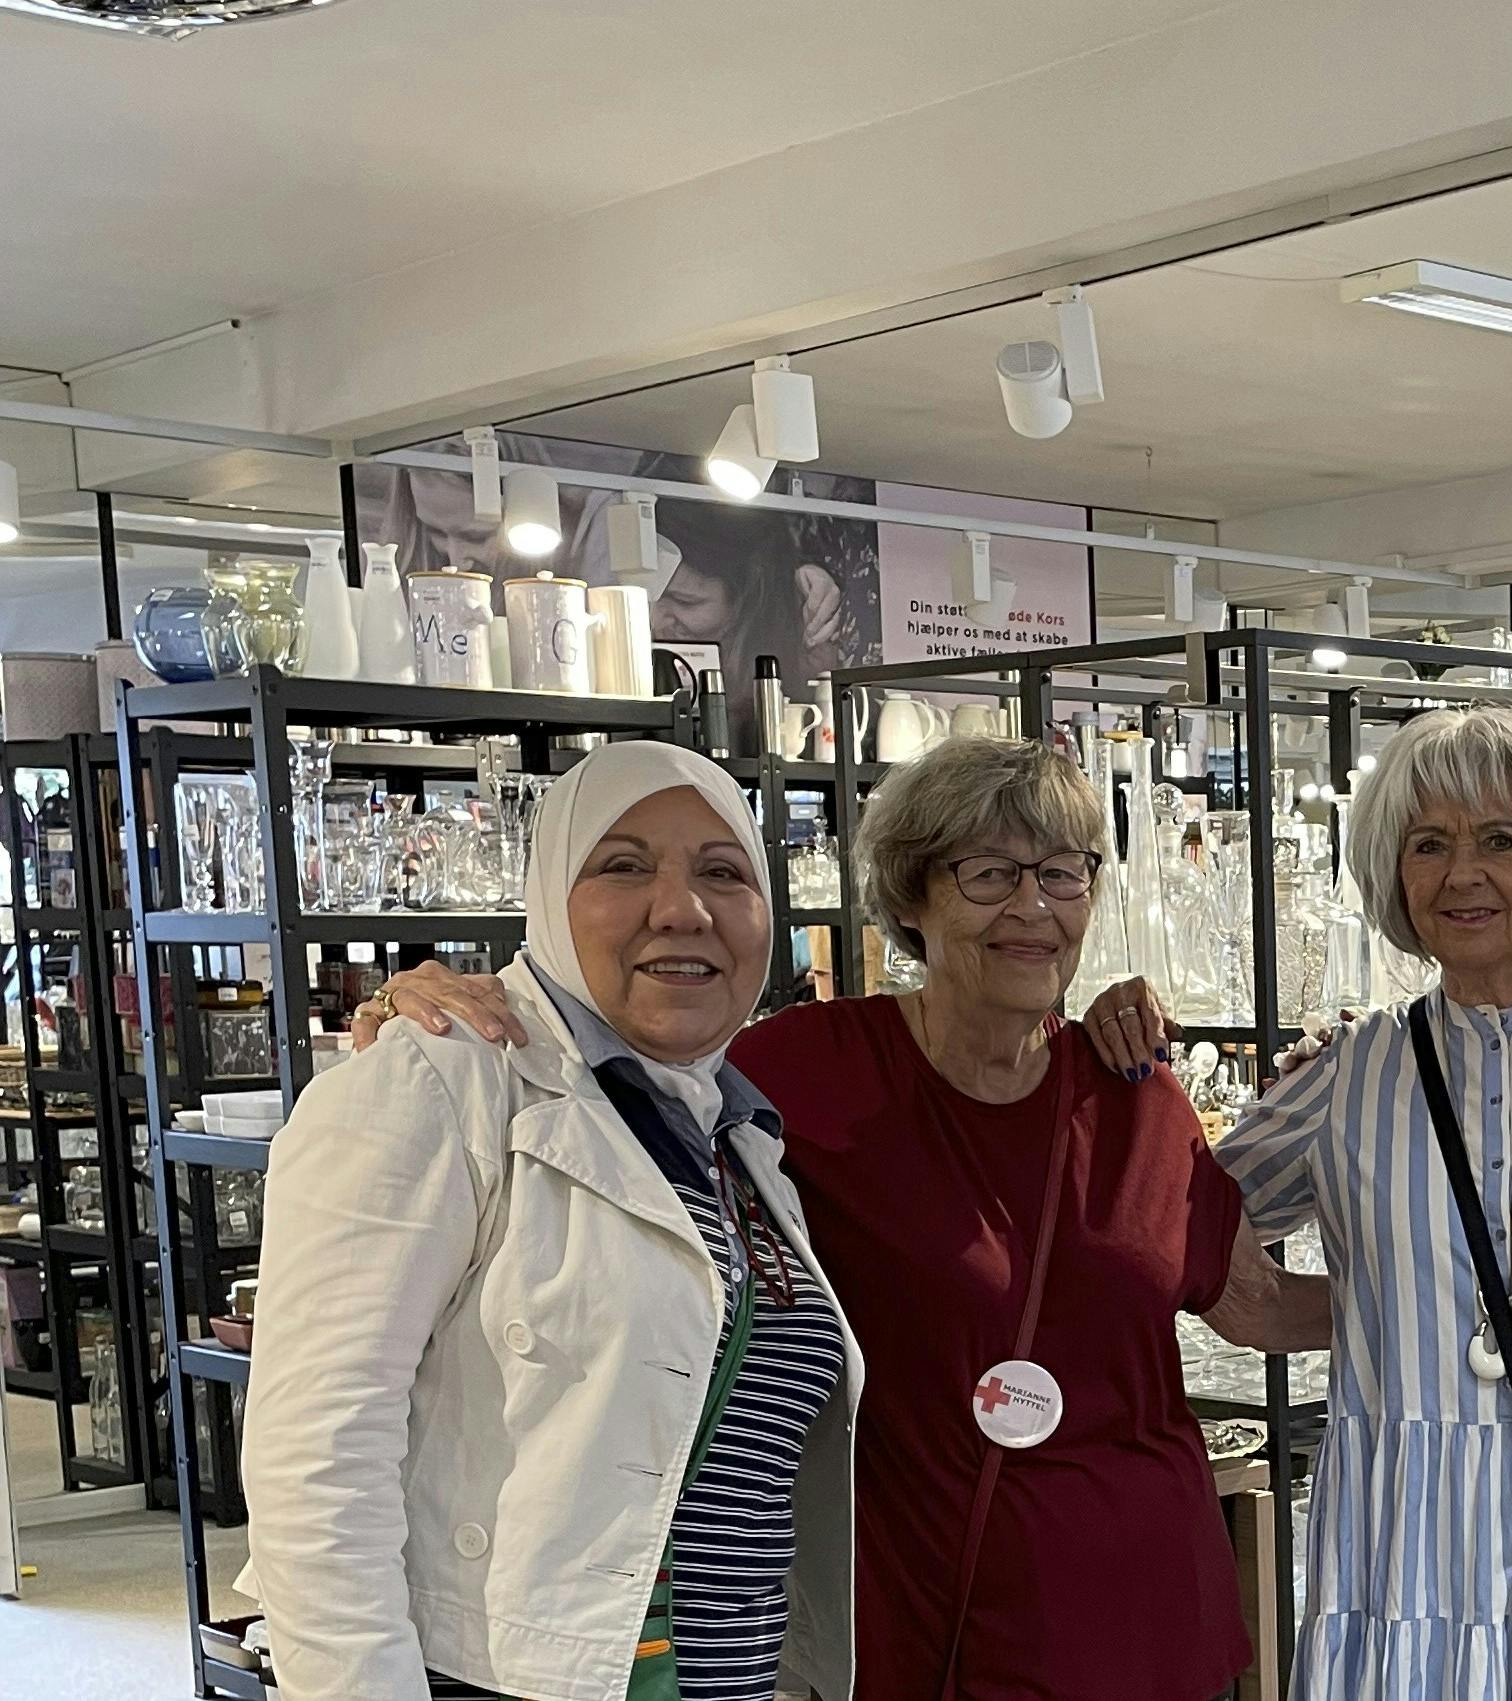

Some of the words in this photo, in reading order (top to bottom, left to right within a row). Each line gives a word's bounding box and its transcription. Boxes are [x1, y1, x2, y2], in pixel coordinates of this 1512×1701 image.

[911, 600, 933, 614] Din
[937, 603, 968, 617] støt
[1008, 609, 1032, 623] øde
[1036, 612, 1065, 626] Kors
[907, 620, 958, 638] hjælper
[963, 628, 979, 639] os
[983, 628, 1011, 641] med
[1015, 631, 1028, 643] at
[1032, 632, 1068, 645] skabe
[926, 643, 967, 659] aktive
[1003, 1384, 1052, 1404] MARIANNE
